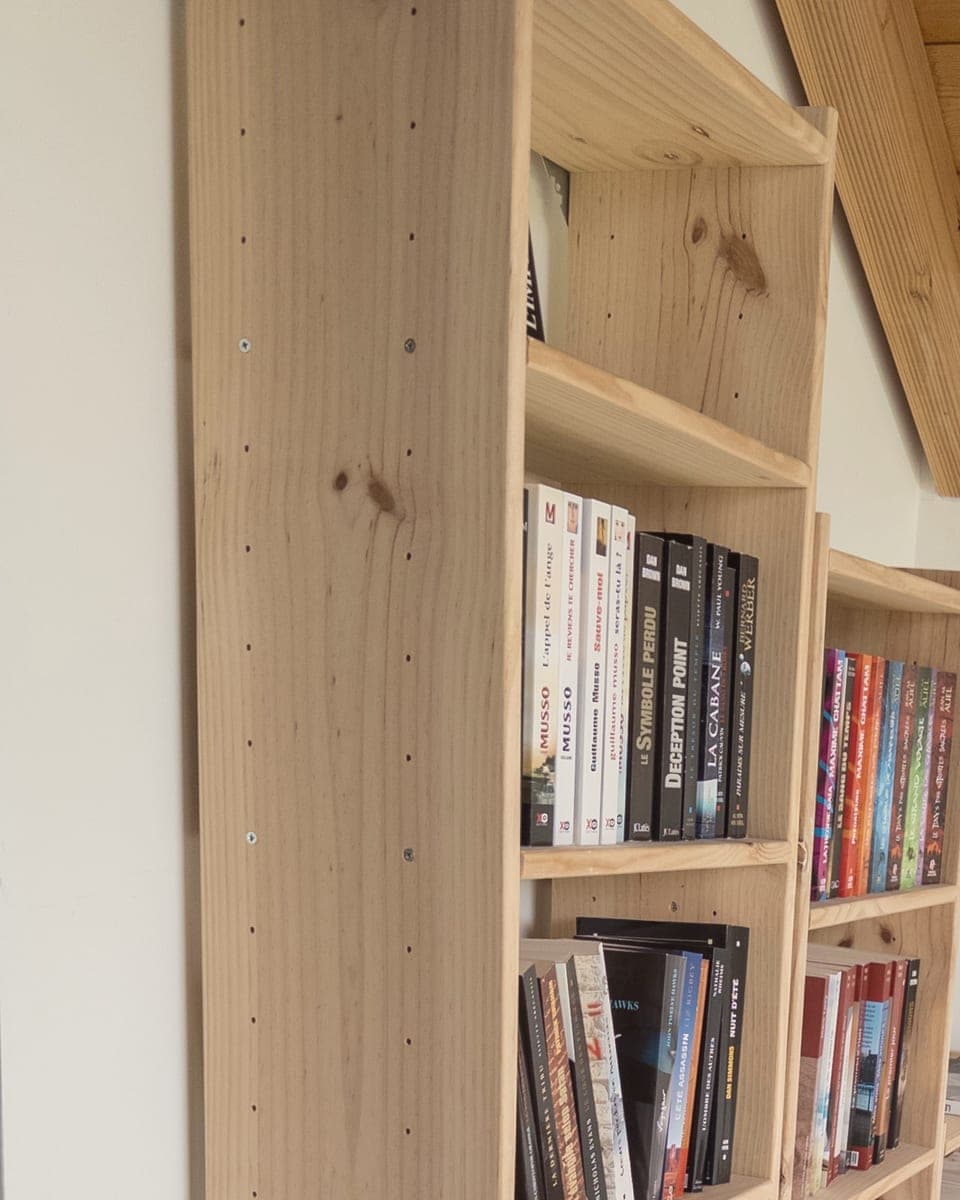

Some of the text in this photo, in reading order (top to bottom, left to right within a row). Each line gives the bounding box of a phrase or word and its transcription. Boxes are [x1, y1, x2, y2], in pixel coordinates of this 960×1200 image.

[567, 539, 575, 591] CHERCHER
[716, 555, 724, 591] YOUNG
[543, 593, 551, 610] de
[593, 572, 604, 652] Sauve-moi
[739, 583, 747, 643] BERNARD
[744, 577, 756, 651] WERBER
[566, 608, 574, 649] REVIENS
[636, 606, 657, 765] LE SYMBOLE PERDU
[707, 650, 722, 767] LA CABANE
[540, 686, 550, 749] MUSSO
[562, 686, 572, 752] MUSSO
[590, 662, 600, 772] Guillaume Musso
[665, 637, 688, 788] DECEPTION POINT
[738, 691, 746, 733] MESURE
[828, 658, 843, 778] MAXIME CHATTAM
[855, 664, 871, 779] MAXIME CHATTAM
[736, 757, 744, 796] PARADIS
[611, 999, 640, 1011] AWKS
[729, 1013, 737, 1038] NUIT
[677, 1033, 689, 1087] ASSASSIN
[706, 1037, 715, 1071] AUTRES
[726, 1046, 734, 1082] SIMMONS
[538, 1064, 547, 1101] TRIBU
[586, 1118, 596, 1149] EVANS
[551, 1172, 558, 1187] LA
